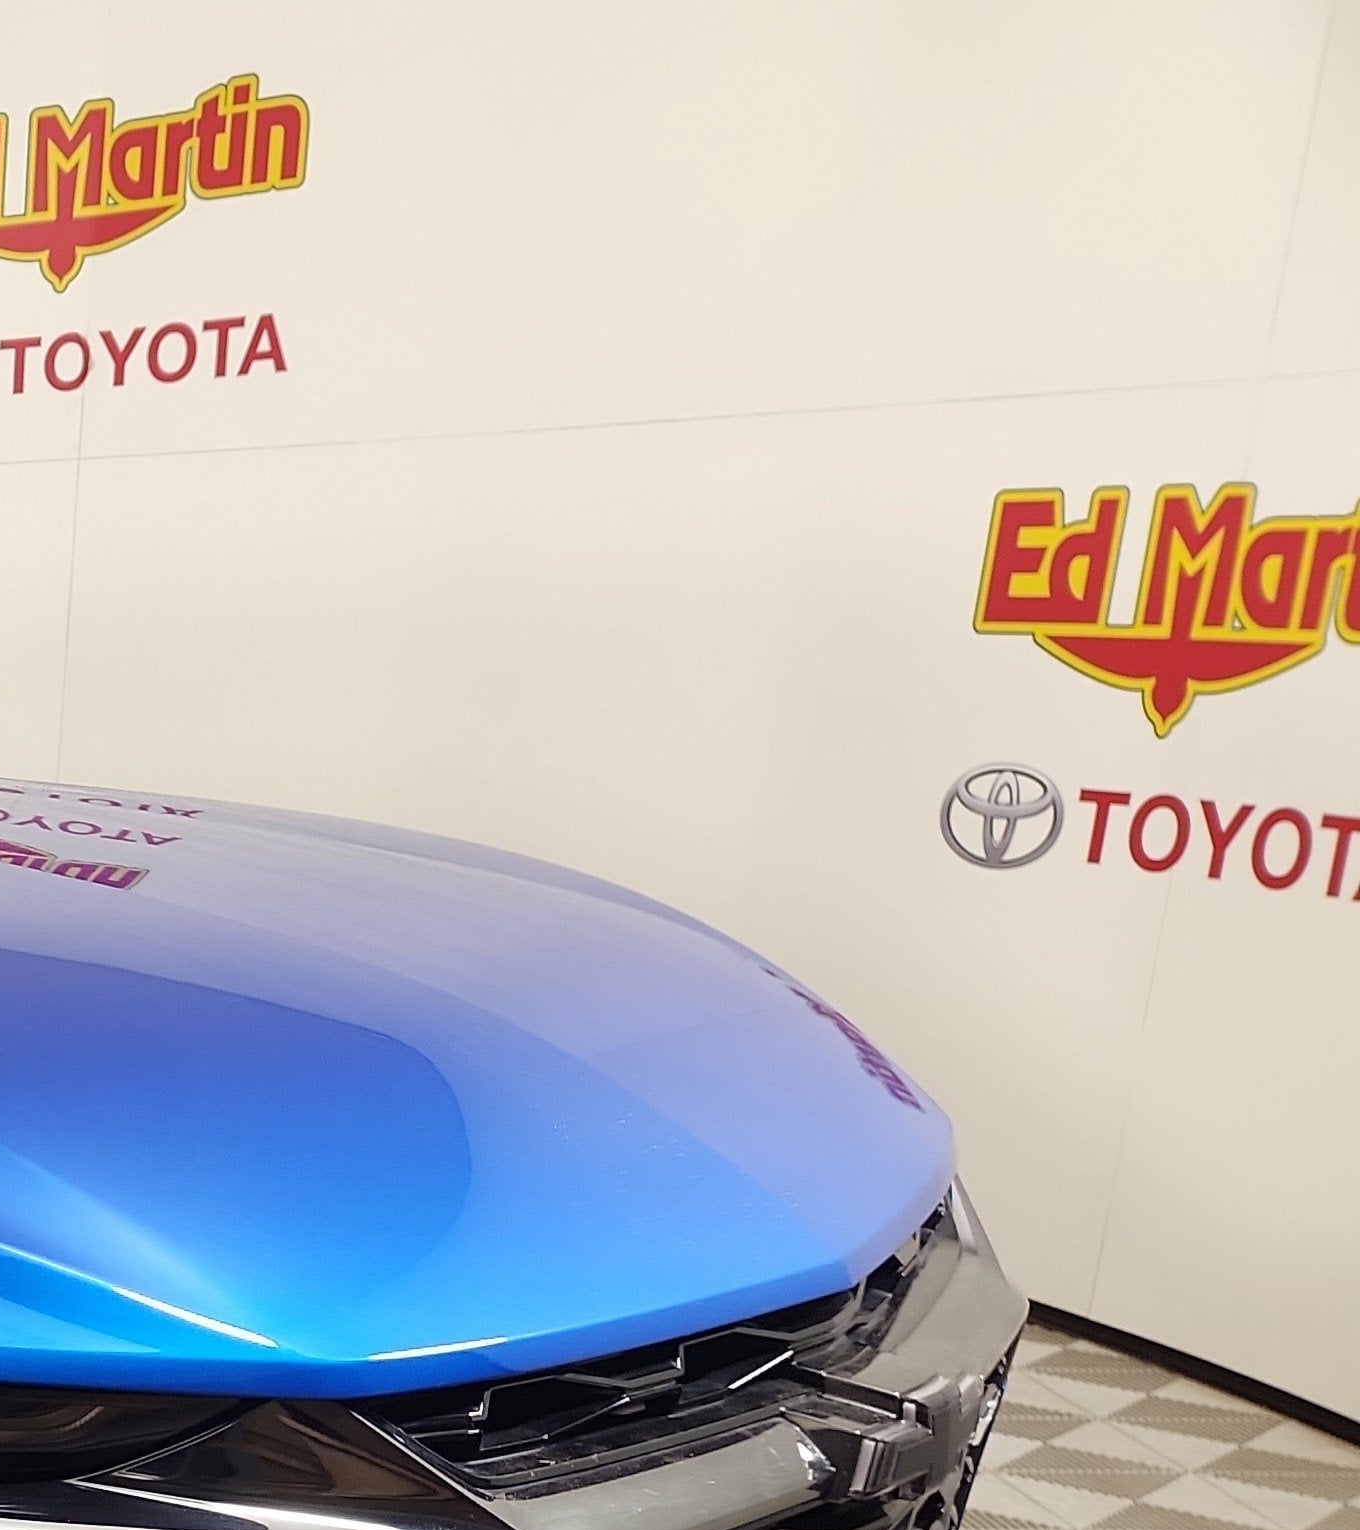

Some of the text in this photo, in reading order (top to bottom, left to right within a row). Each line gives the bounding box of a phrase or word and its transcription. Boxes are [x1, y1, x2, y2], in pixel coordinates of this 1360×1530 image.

[27, 73, 310, 222] Martin
[0, 313, 288, 395] TOYOTA
[973, 482, 1360, 645] Ed Mar
[1078, 788, 1360, 904] TOYOT
